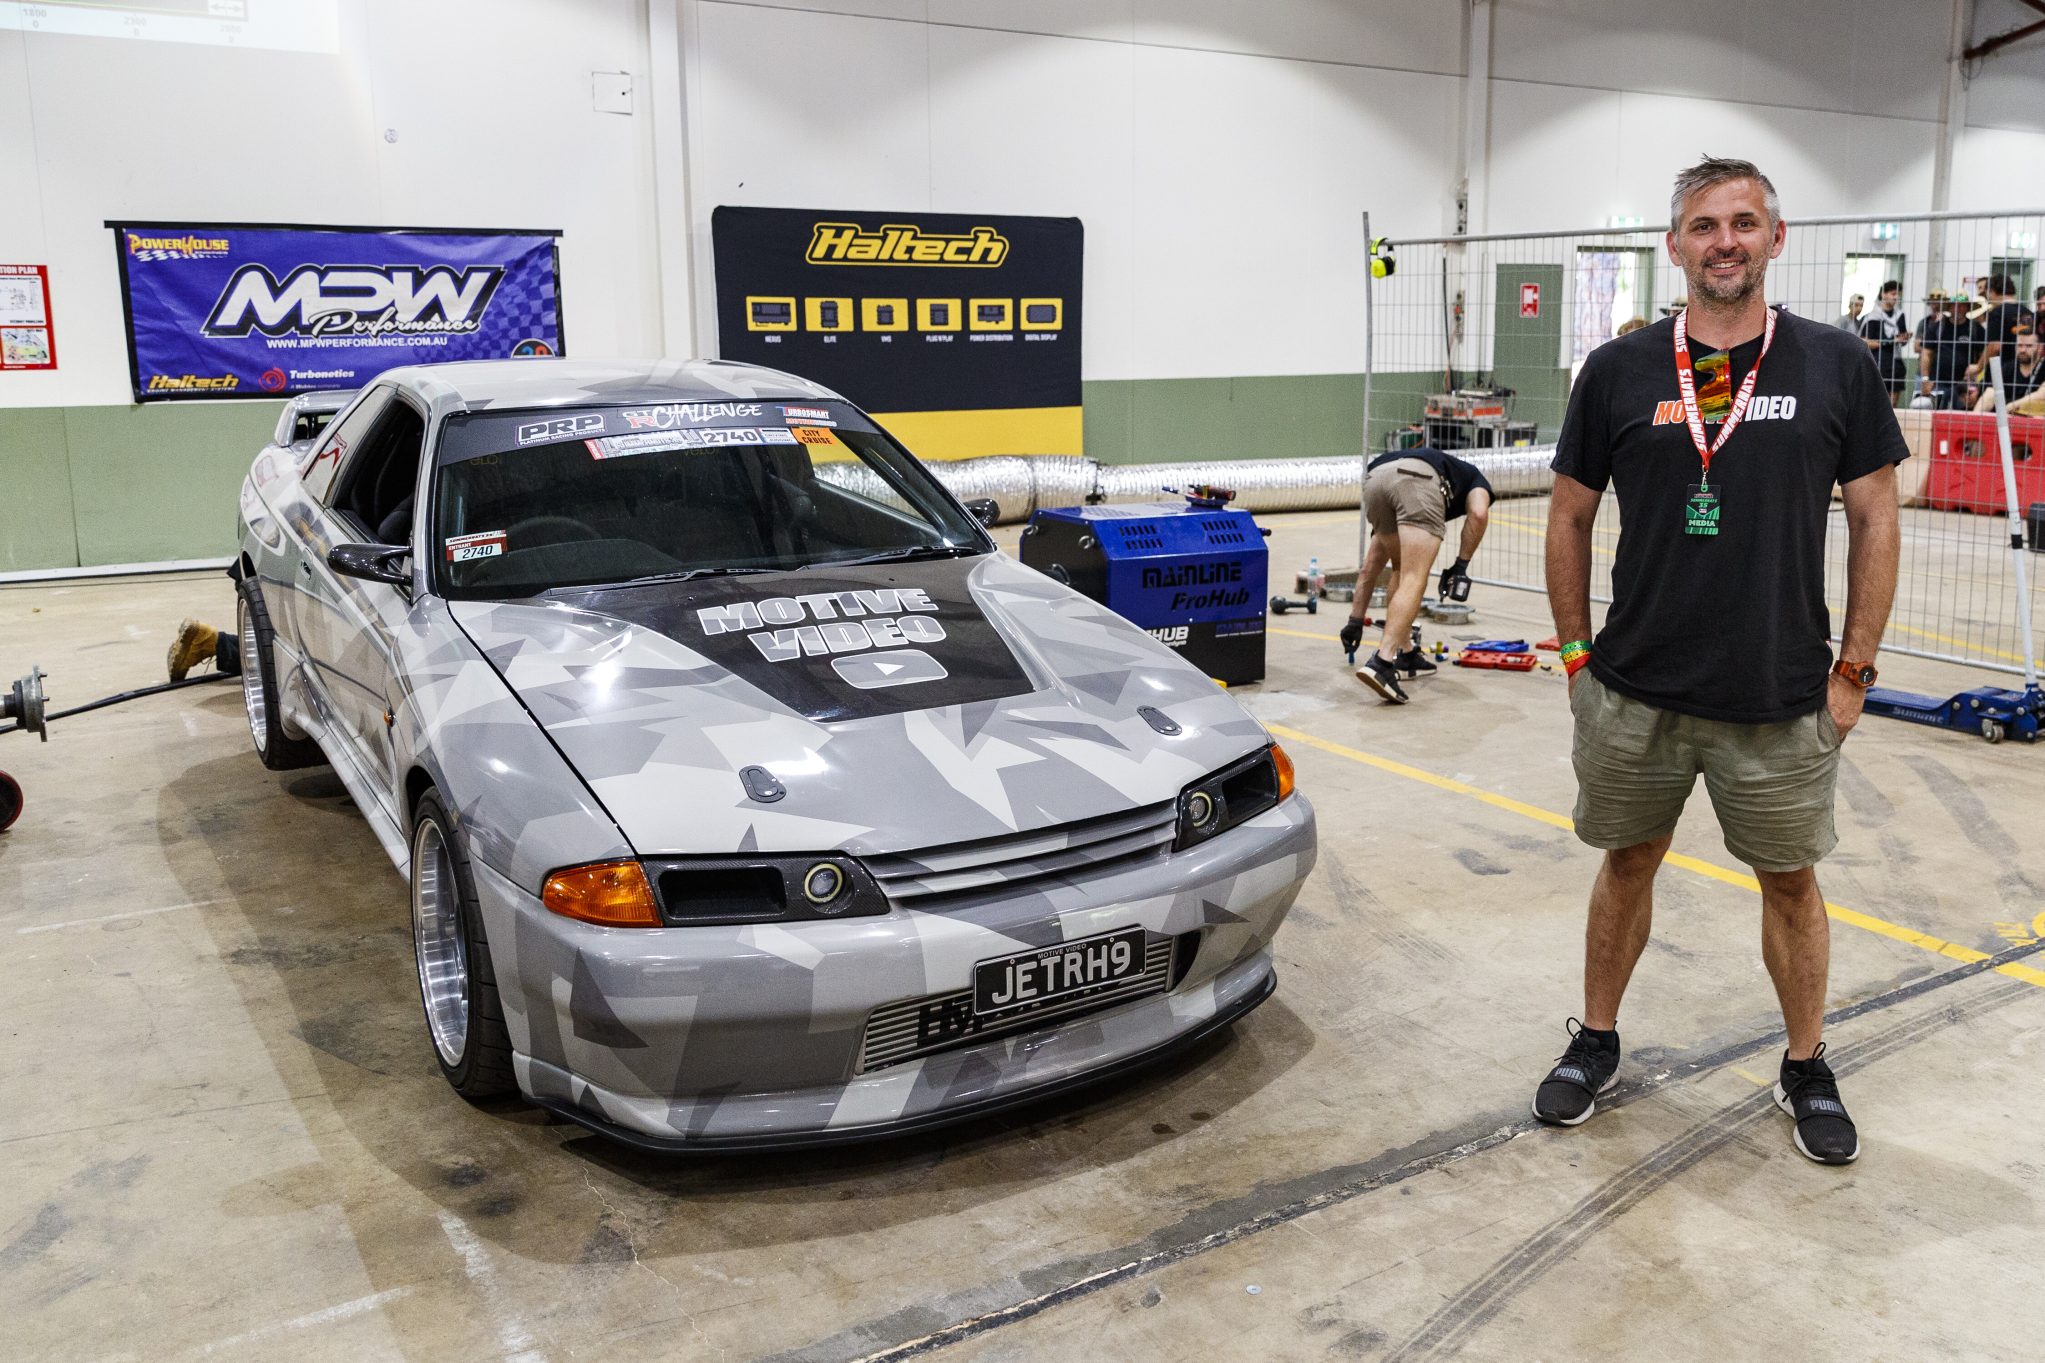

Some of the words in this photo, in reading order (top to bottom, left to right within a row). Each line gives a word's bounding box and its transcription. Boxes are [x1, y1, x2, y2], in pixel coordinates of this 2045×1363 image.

[807, 225, 1007, 265] Haltech
[18, 266, 38, 275] PLAN
[308, 306, 480, 337] Performance
[267, 337, 447, 348] WWW.MPWPERFORMANCE.COM.AU
[149, 374, 239, 389] Haltech
[289, 369, 355, 379] Turbonetics
[652, 403, 763, 428] CHALLENGE
[1678, 369, 1708, 453] SUMMERNATS
[1712, 370, 1757, 454] SUMMERNATS
[1739, 396, 1797, 421] IDEO
[521, 416, 603, 439] PRP
[802, 429, 821, 437] CITY
[520, 437, 551, 445] PLATINUM
[551, 432, 574, 440] RACING
[703, 431, 759, 443] 2740
[802, 436, 833, 445] CRUISE
[1688, 519, 1716, 527] MEDIA
[462, 545, 494, 559] 2740
[1171, 587, 1249, 611] ProHub
[697, 588, 939, 635] MOTIVE
[747, 615, 947, 662] VIDEO
[1145, 626, 1189, 643] HUB
[1037, 949, 1064, 960] MOTIVE
[1065, 943, 1087, 953] VIDEO
[991, 941, 1131, 1005] JETRH9
[1554, 1067, 1586, 1083] PUMA
[1809, 1099, 1845, 1116] PUMA
